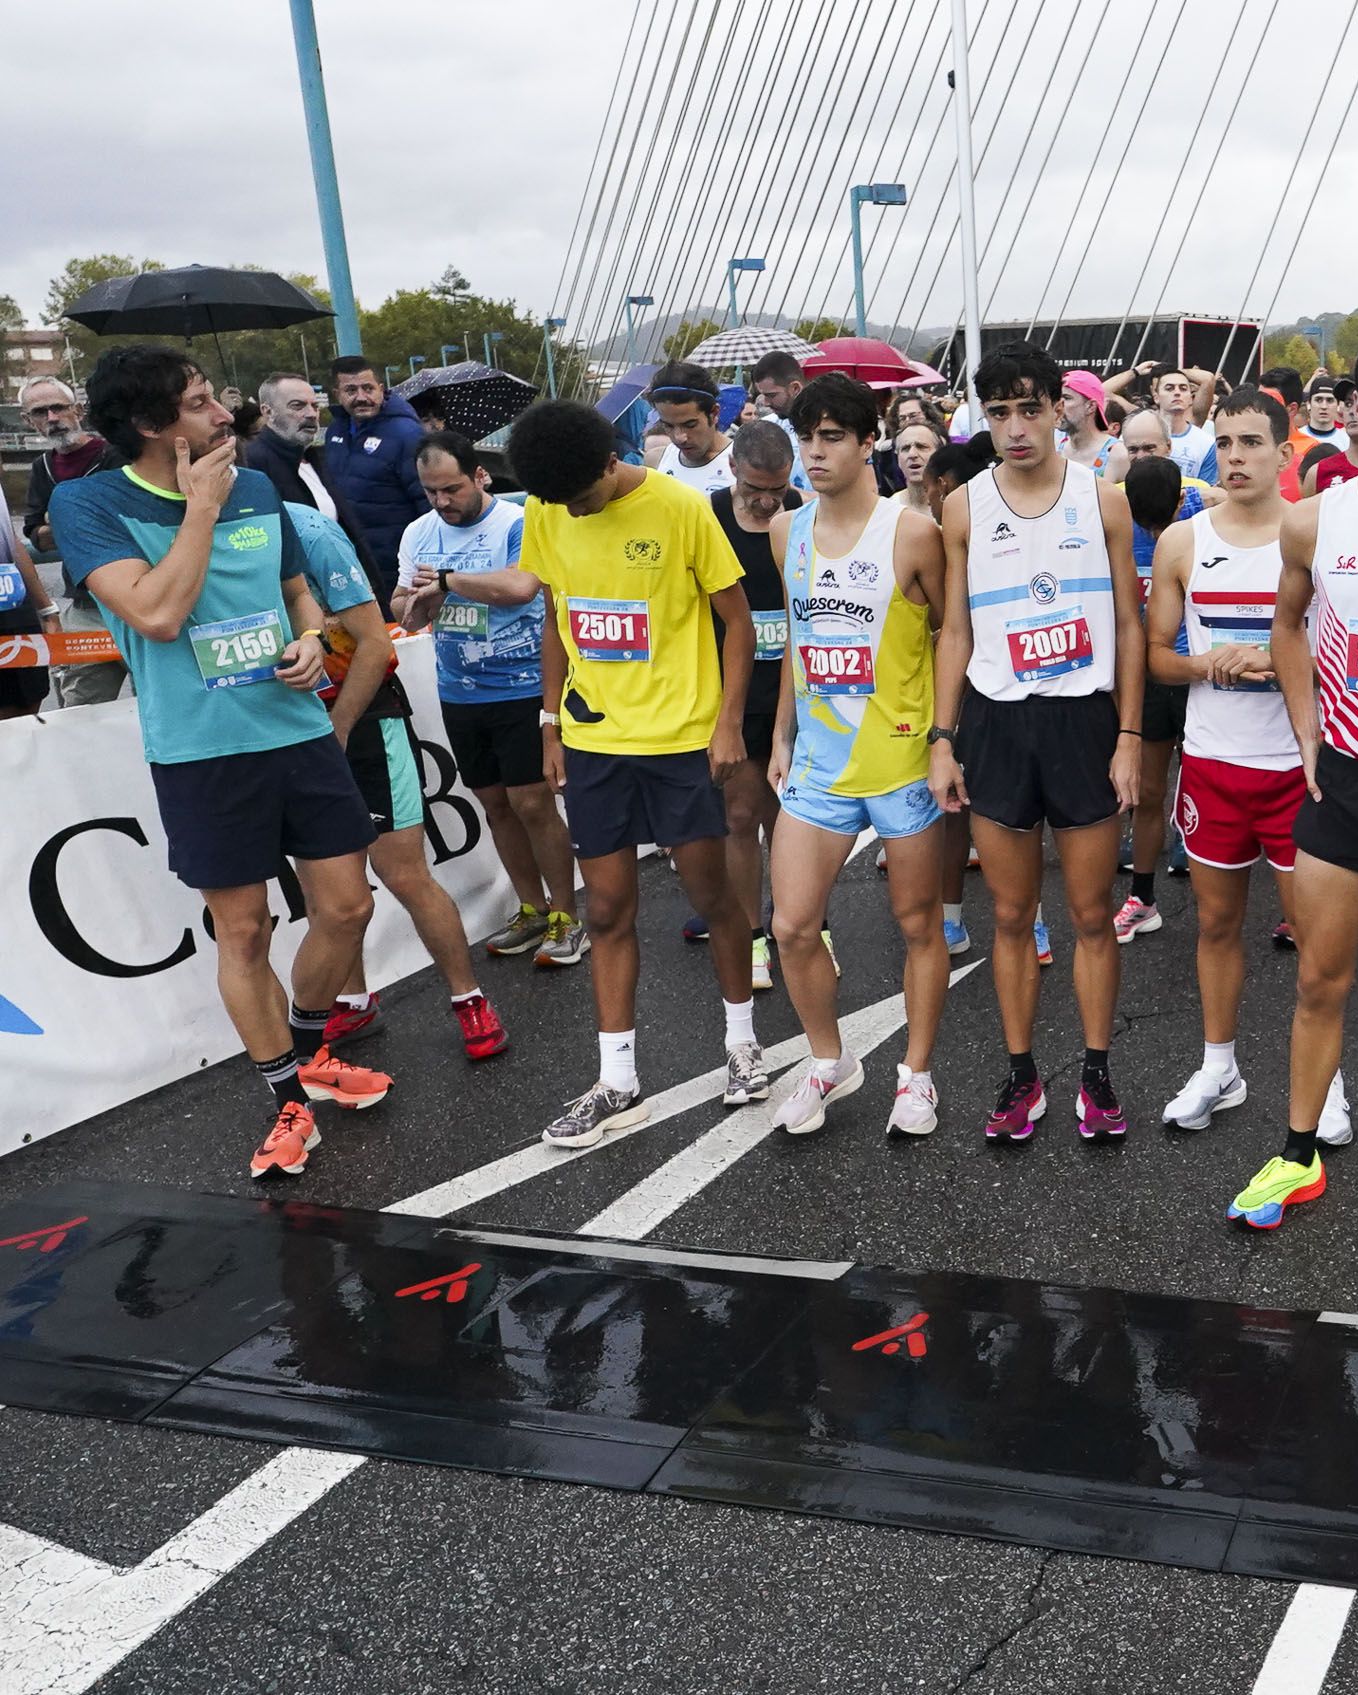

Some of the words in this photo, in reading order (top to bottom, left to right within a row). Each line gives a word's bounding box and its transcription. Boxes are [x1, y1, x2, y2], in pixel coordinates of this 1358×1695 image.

[438, 606, 478, 627] 2280
[792, 597, 875, 623] Quescrem
[577, 613, 635, 641] 2501
[755, 622, 788, 642] 203
[211, 628, 278, 668] 2159
[1019, 623, 1077, 662] 2007
[807, 647, 861, 676] 2002
